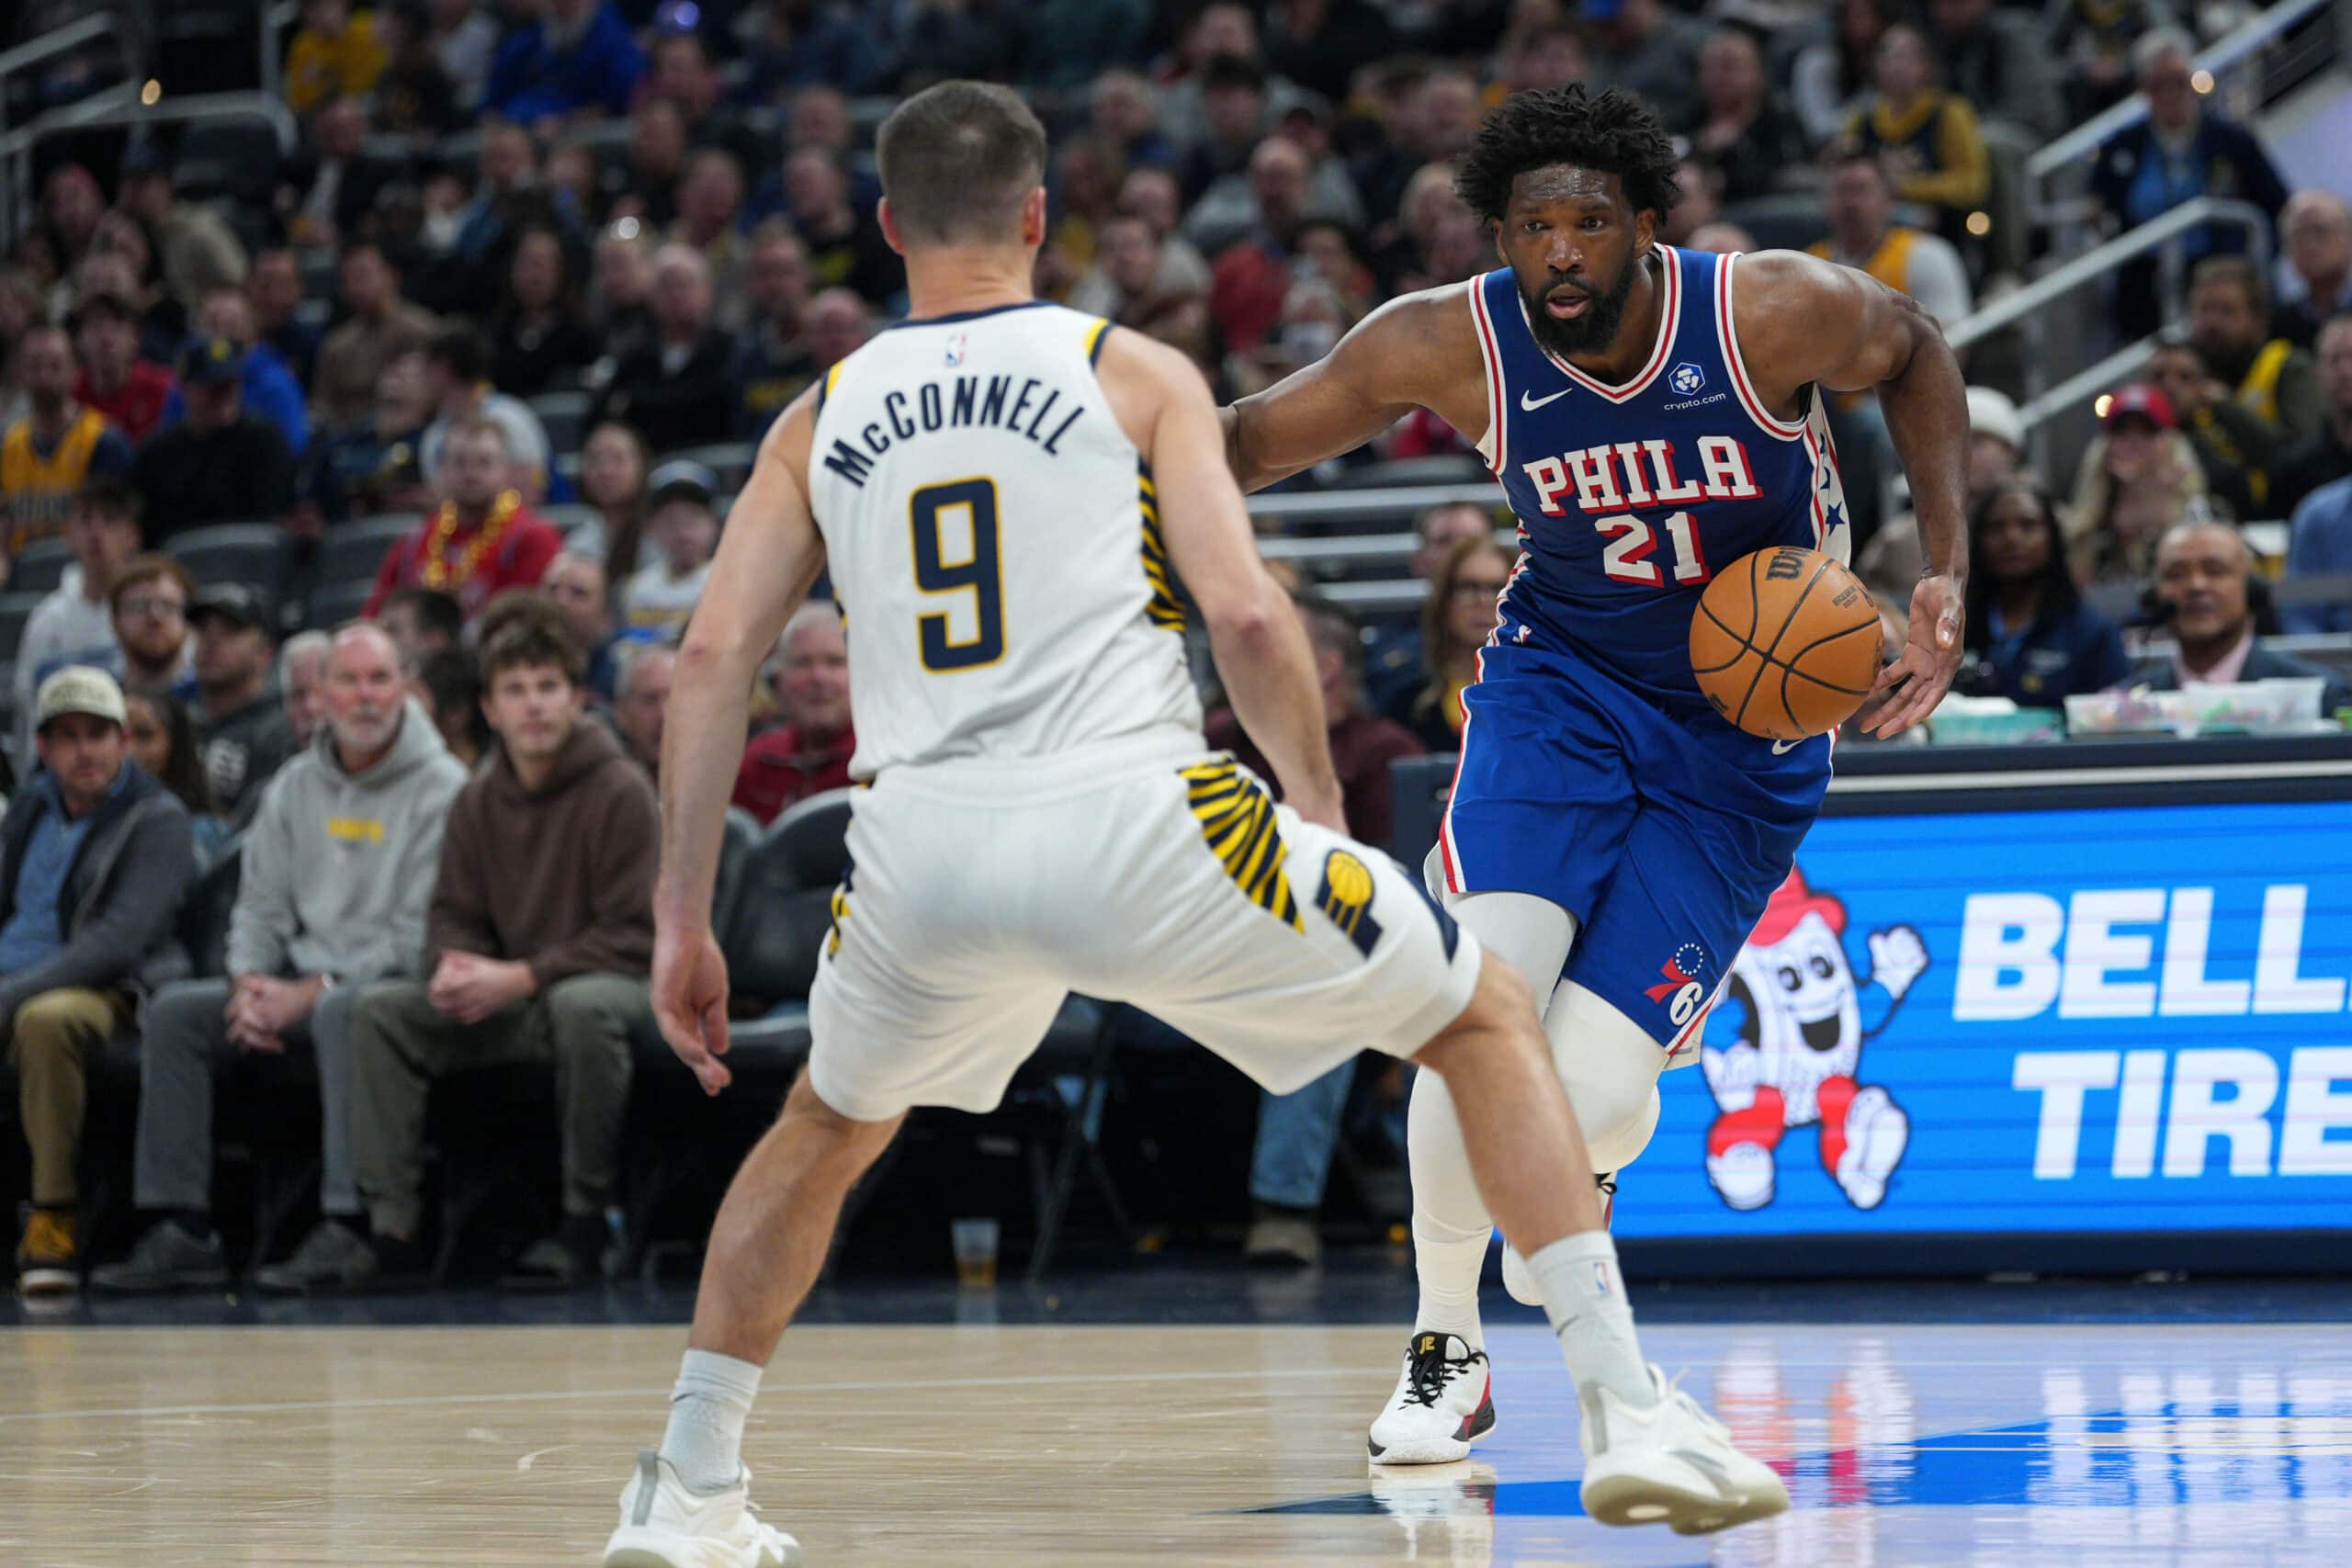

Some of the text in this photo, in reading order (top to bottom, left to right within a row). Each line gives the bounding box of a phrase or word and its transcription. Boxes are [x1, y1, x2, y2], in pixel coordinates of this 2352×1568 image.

[823, 374, 1087, 490] McCONNELL
[1664, 392, 1727, 411] crypto.com
[1522, 435, 1763, 516] PHILA
[910, 475, 1009, 676] 9
[1594, 511, 1711, 588] 21
[1952, 884, 2352, 1021] BELL
[2012, 1045, 2352, 1180] TIRE
